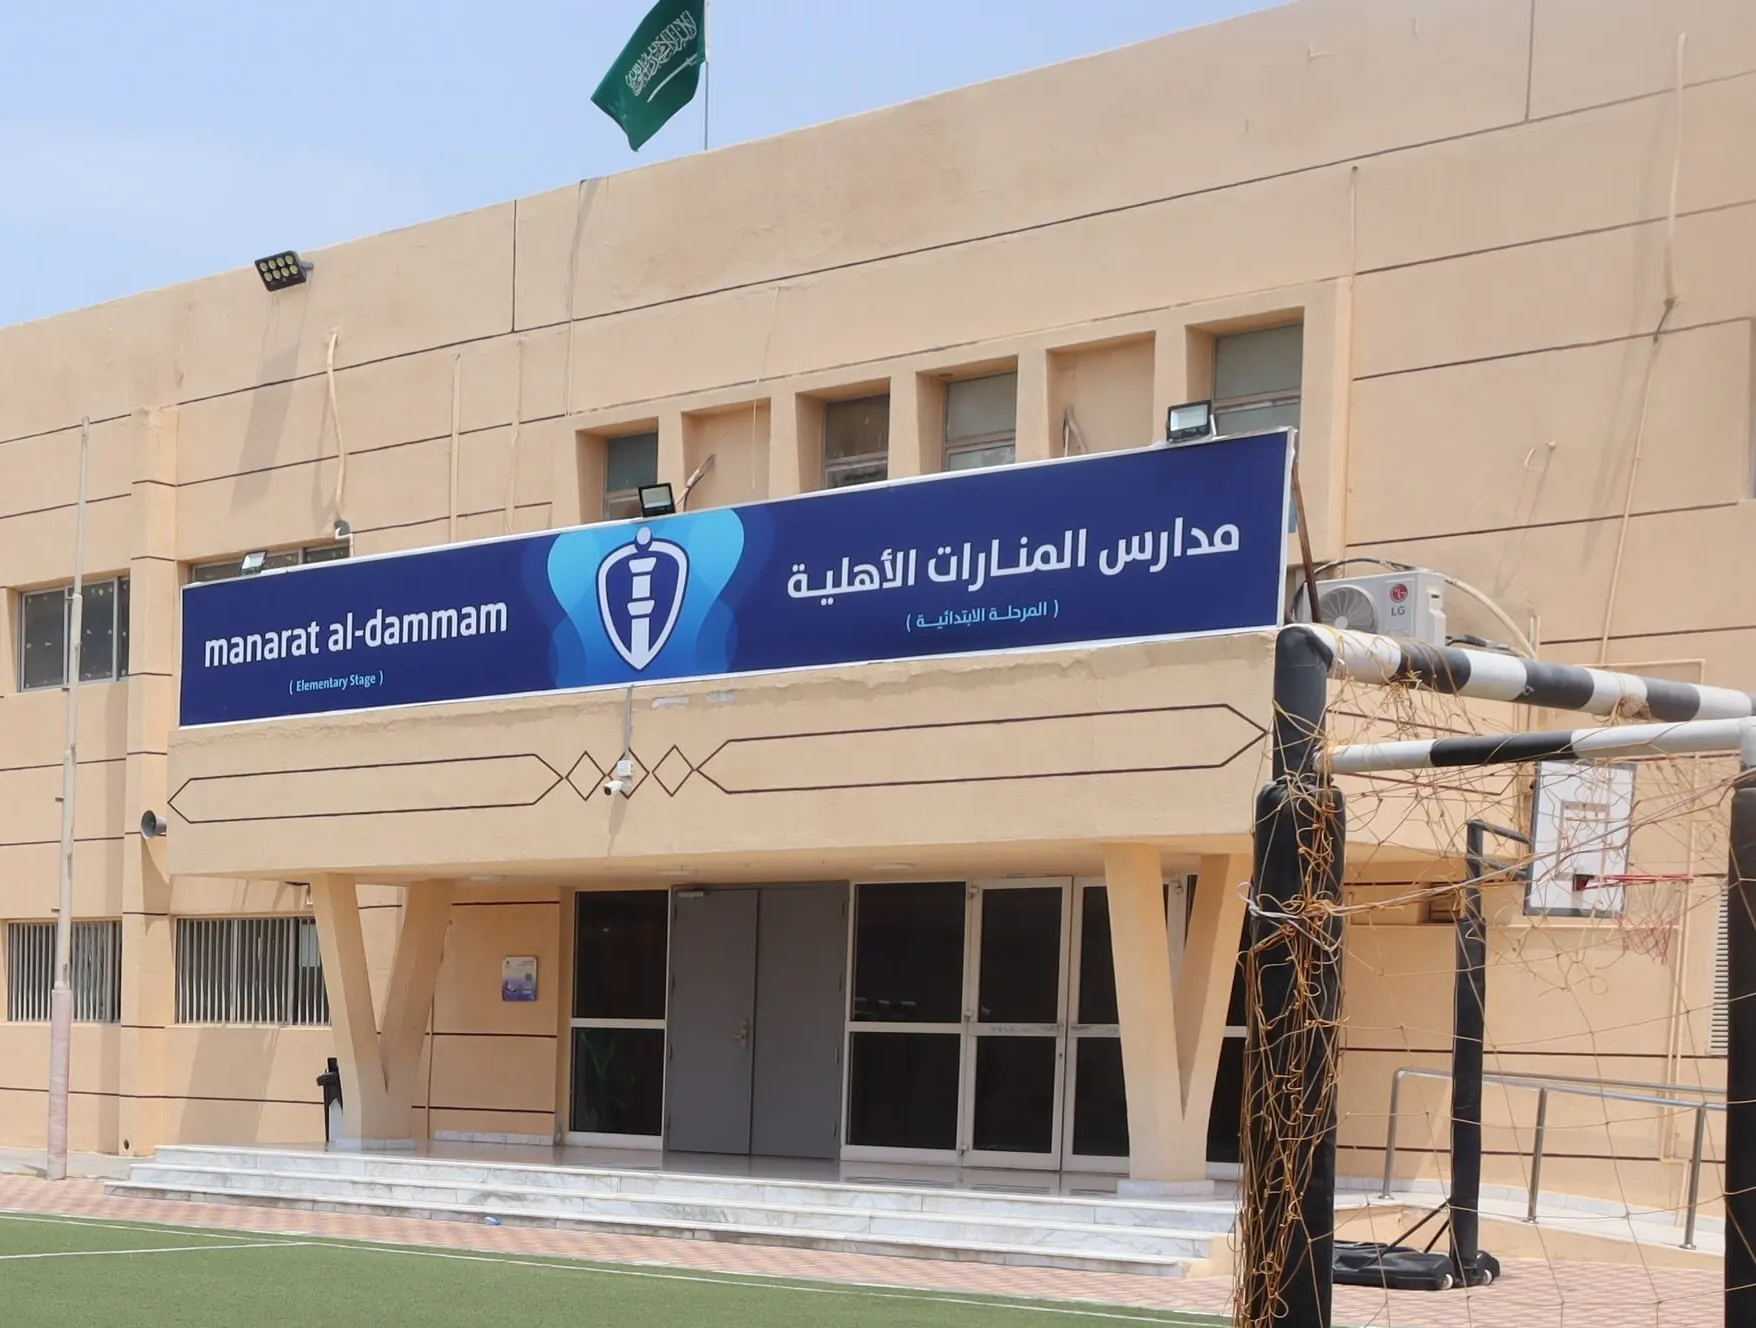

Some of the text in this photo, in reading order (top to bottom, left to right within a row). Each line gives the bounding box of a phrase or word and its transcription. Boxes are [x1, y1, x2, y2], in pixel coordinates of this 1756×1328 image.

[787, 517, 1240, 606] مدارس المنارات الأهلية
[916, 608, 985, 630] الابتدائية
[988, 601, 1047, 623] المرحلة
[1391, 605, 1406, 617] LG
[204, 601, 508, 668] manarat al-dammam
[296, 677, 348, 692] Elementary
[349, 674, 376, 688] Stage
